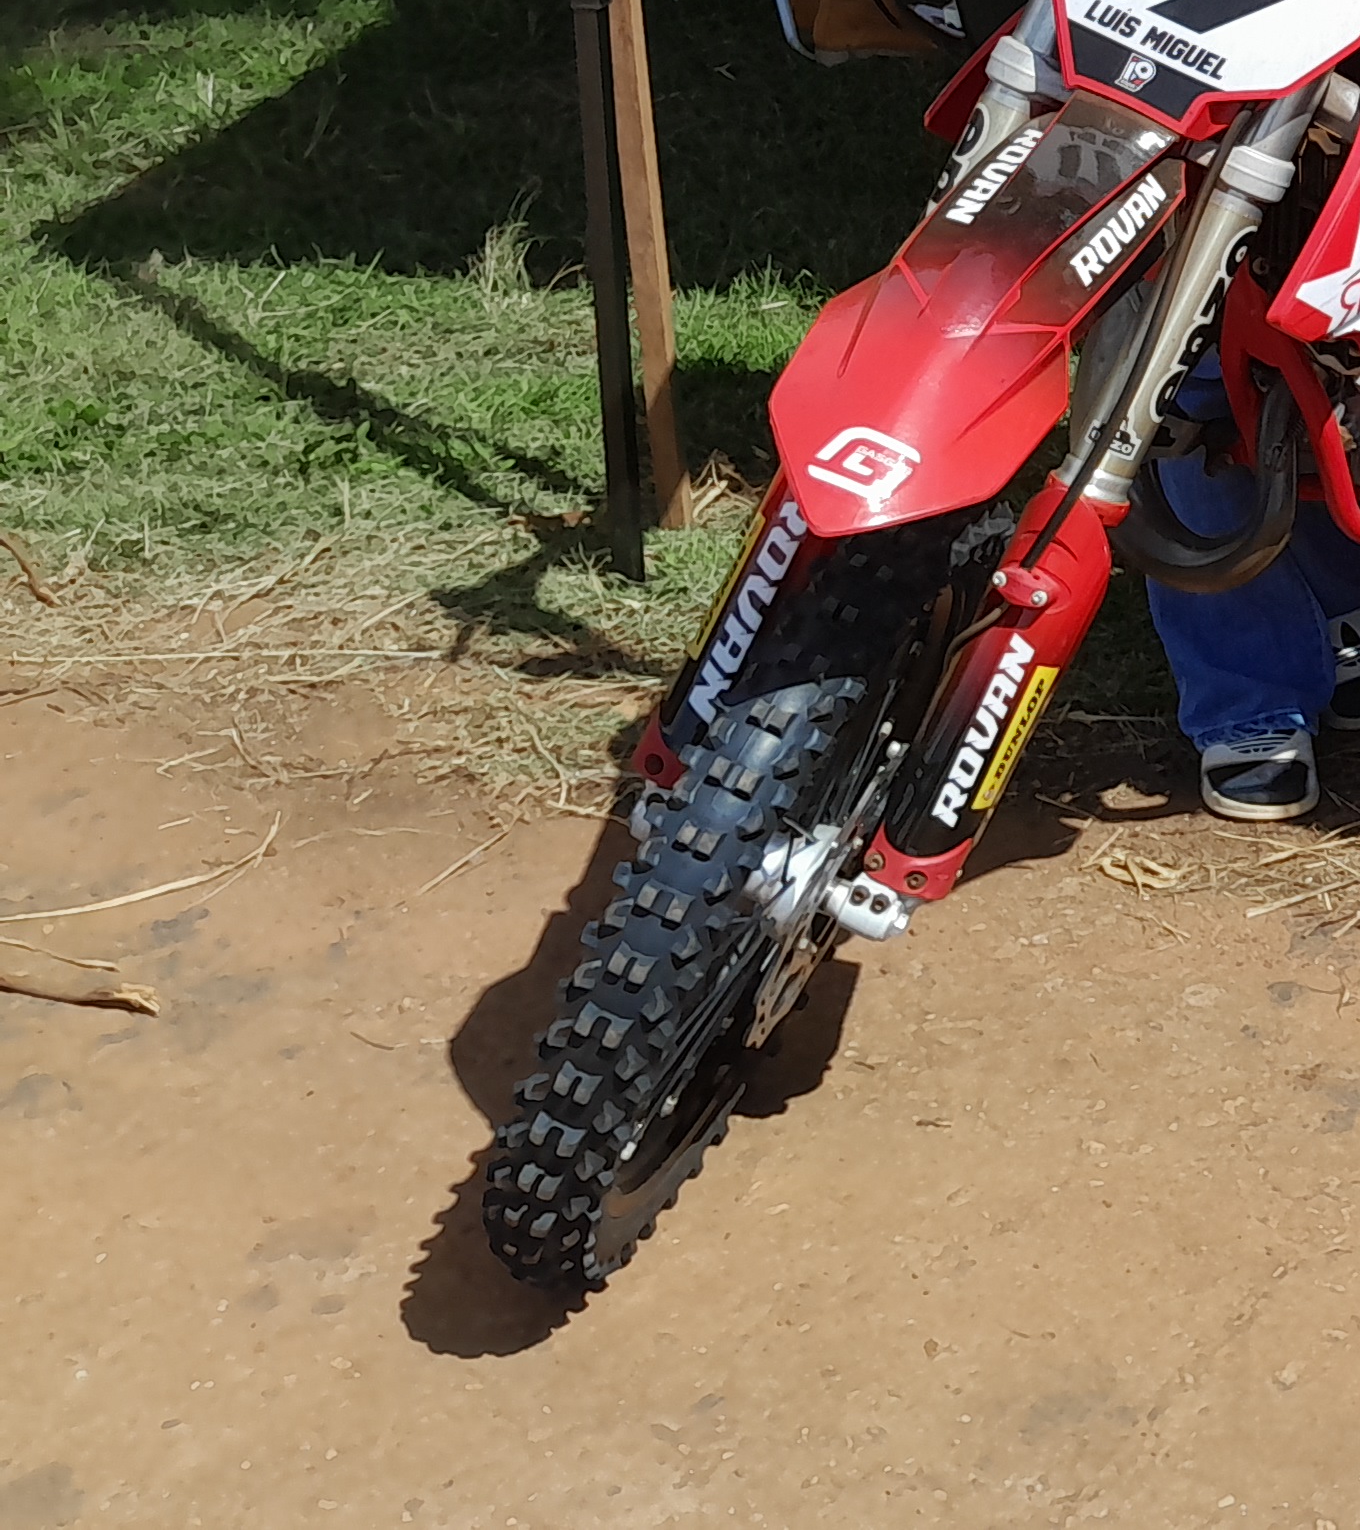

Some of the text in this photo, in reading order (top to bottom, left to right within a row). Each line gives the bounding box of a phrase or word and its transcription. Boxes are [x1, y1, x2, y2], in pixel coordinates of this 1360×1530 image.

[1140, 25, 1229, 81] MIGUEL
[945, 129, 1044, 225] ROVAN
[1069, 172, 1168, 288] ROVAN
[930, 632, 1036, 829] ROVAN
[995, 678, 1045, 780] DUNLOP
